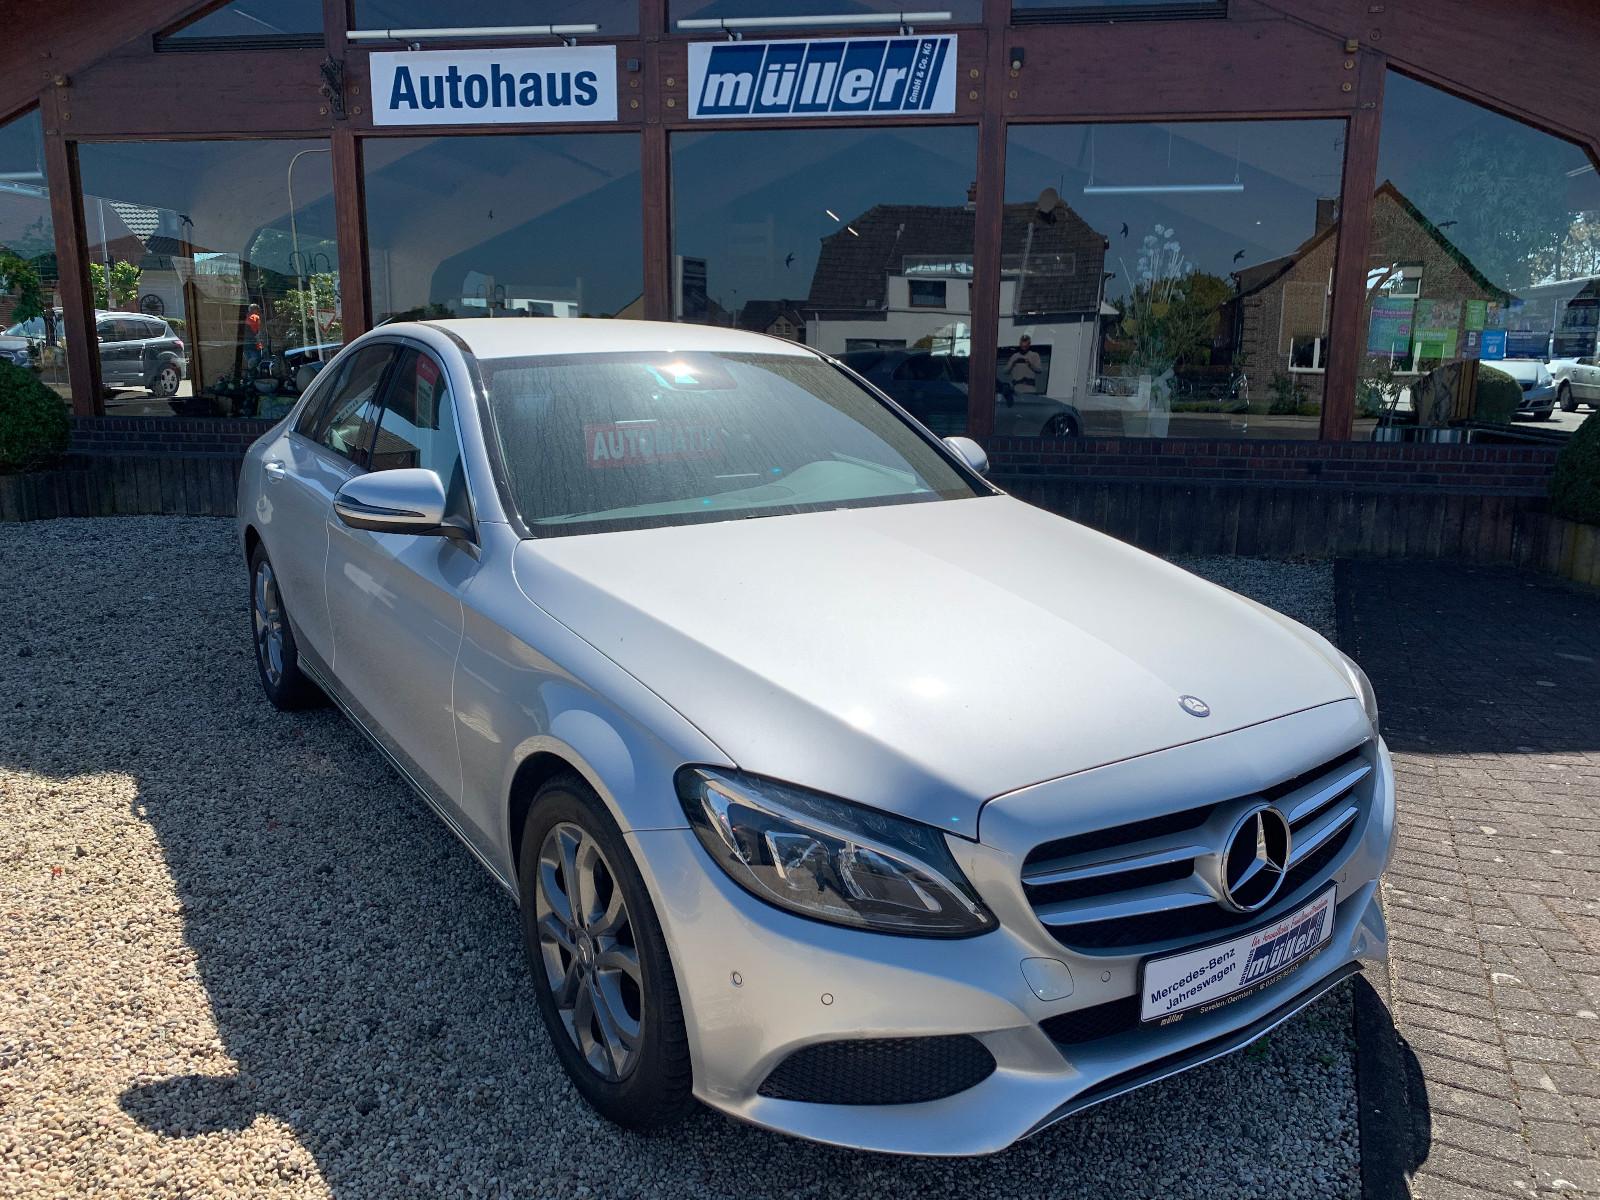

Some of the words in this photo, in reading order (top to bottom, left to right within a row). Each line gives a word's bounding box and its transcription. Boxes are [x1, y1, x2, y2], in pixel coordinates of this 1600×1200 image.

[919, 57, 928, 70] Co.
[922, 43, 932, 54] KG
[388, 63, 599, 110] Autohaus
[703, 62, 906, 107] müller
[909, 79, 921, 102] GmbH
[1150, 947, 1236, 1004] Mercedes-Benz
[1247, 928, 1316, 978] müller
[1166, 962, 1237, 1010] Jahreswagen
